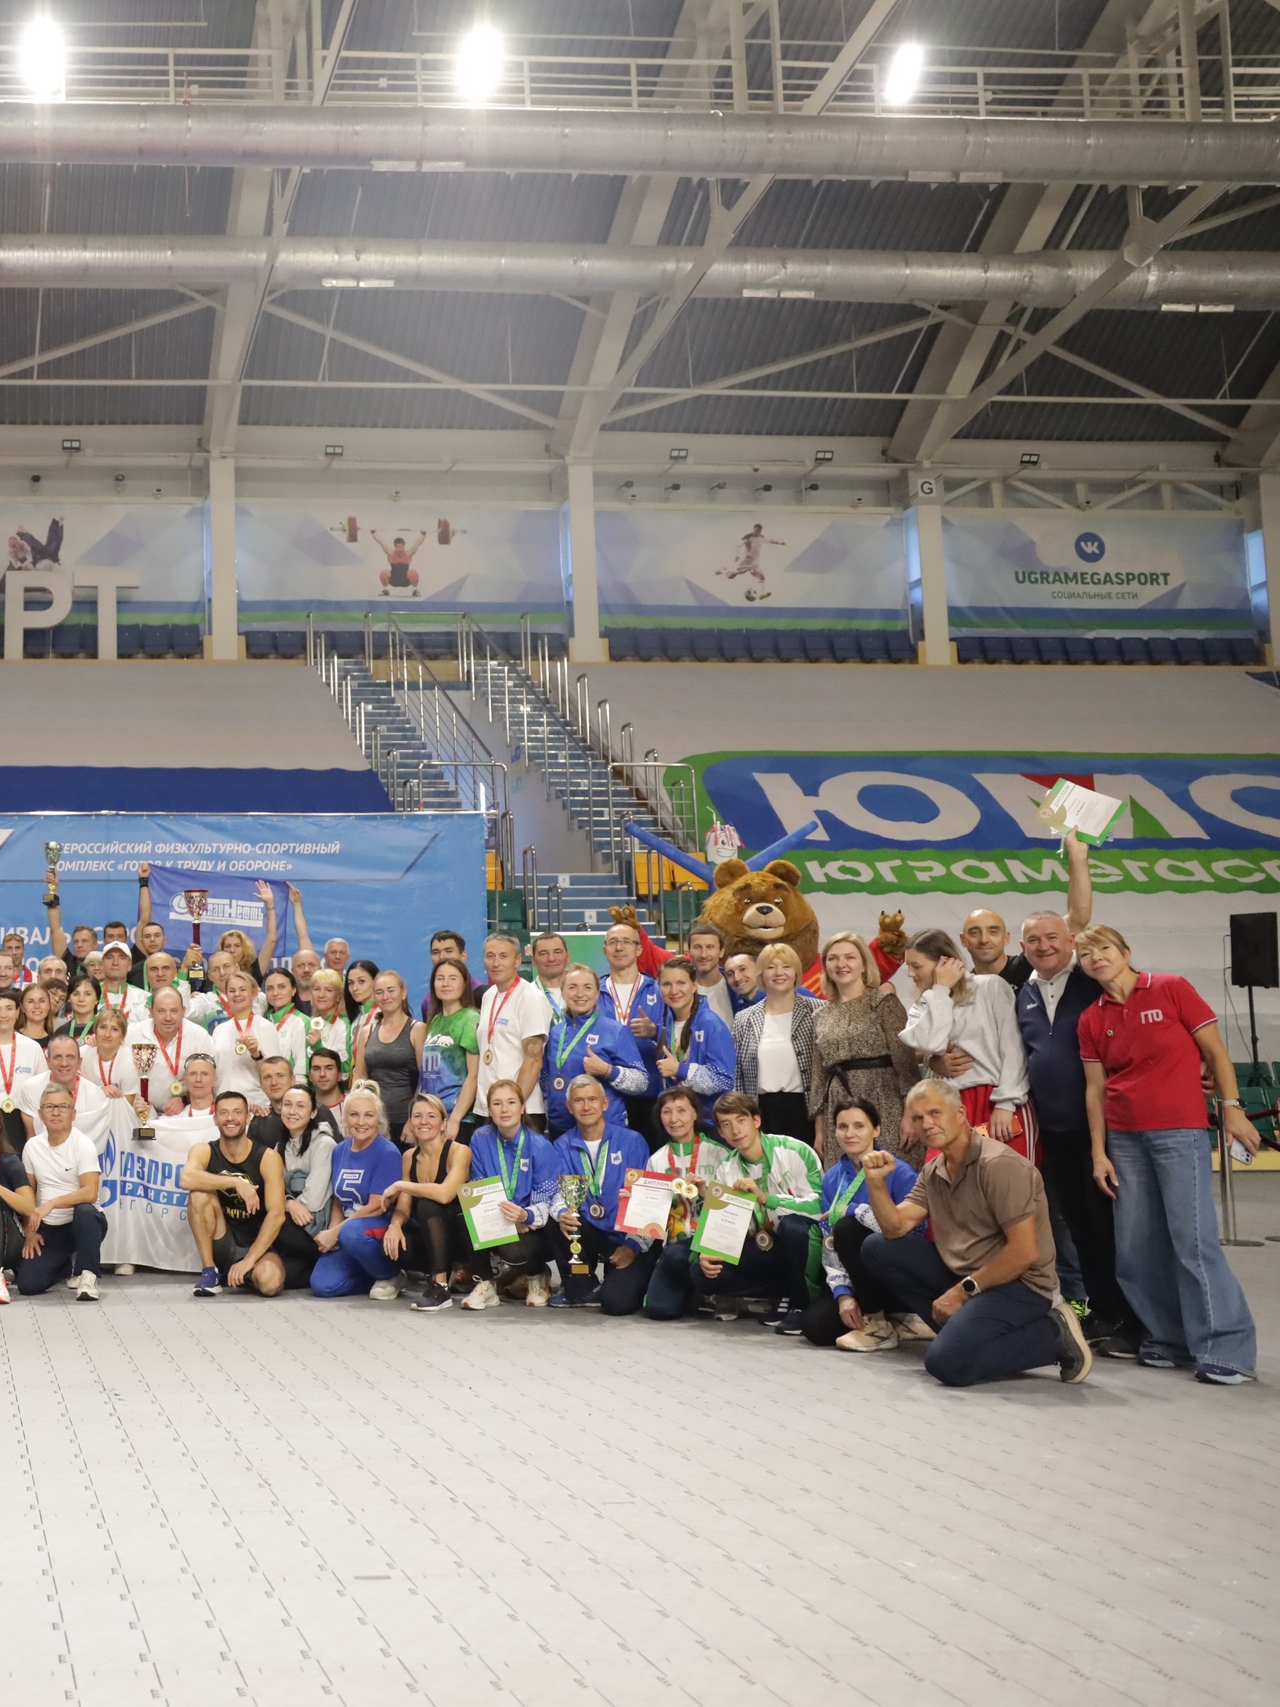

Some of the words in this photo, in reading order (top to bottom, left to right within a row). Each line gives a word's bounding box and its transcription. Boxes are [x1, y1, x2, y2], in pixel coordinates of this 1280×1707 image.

[920, 480, 934, 496] G
[1014, 570, 1171, 586] UGRAMEGASPORT
[1051, 591, 1114, 600] СОЦИАЛЬНЫЕ
[1115, 592, 1138, 600] СЕТИ
[154, 841, 341, 855] ФИЗКУЛЬТУРНО-СПОРТИВНЫЙ
[56, 860, 115, 872] ОМПЛЕКС
[217, 861, 227, 871] И
[229, 860, 293, 872] ОБОРОНЕ»
[1140, 1009, 1163, 1024] ГТО
[422, 1051, 441, 1072] ГТО
[643, 1179, 670, 1188] ДИПЛОМ
[725, 1195, 752, 1207] ДИПЛОМ
